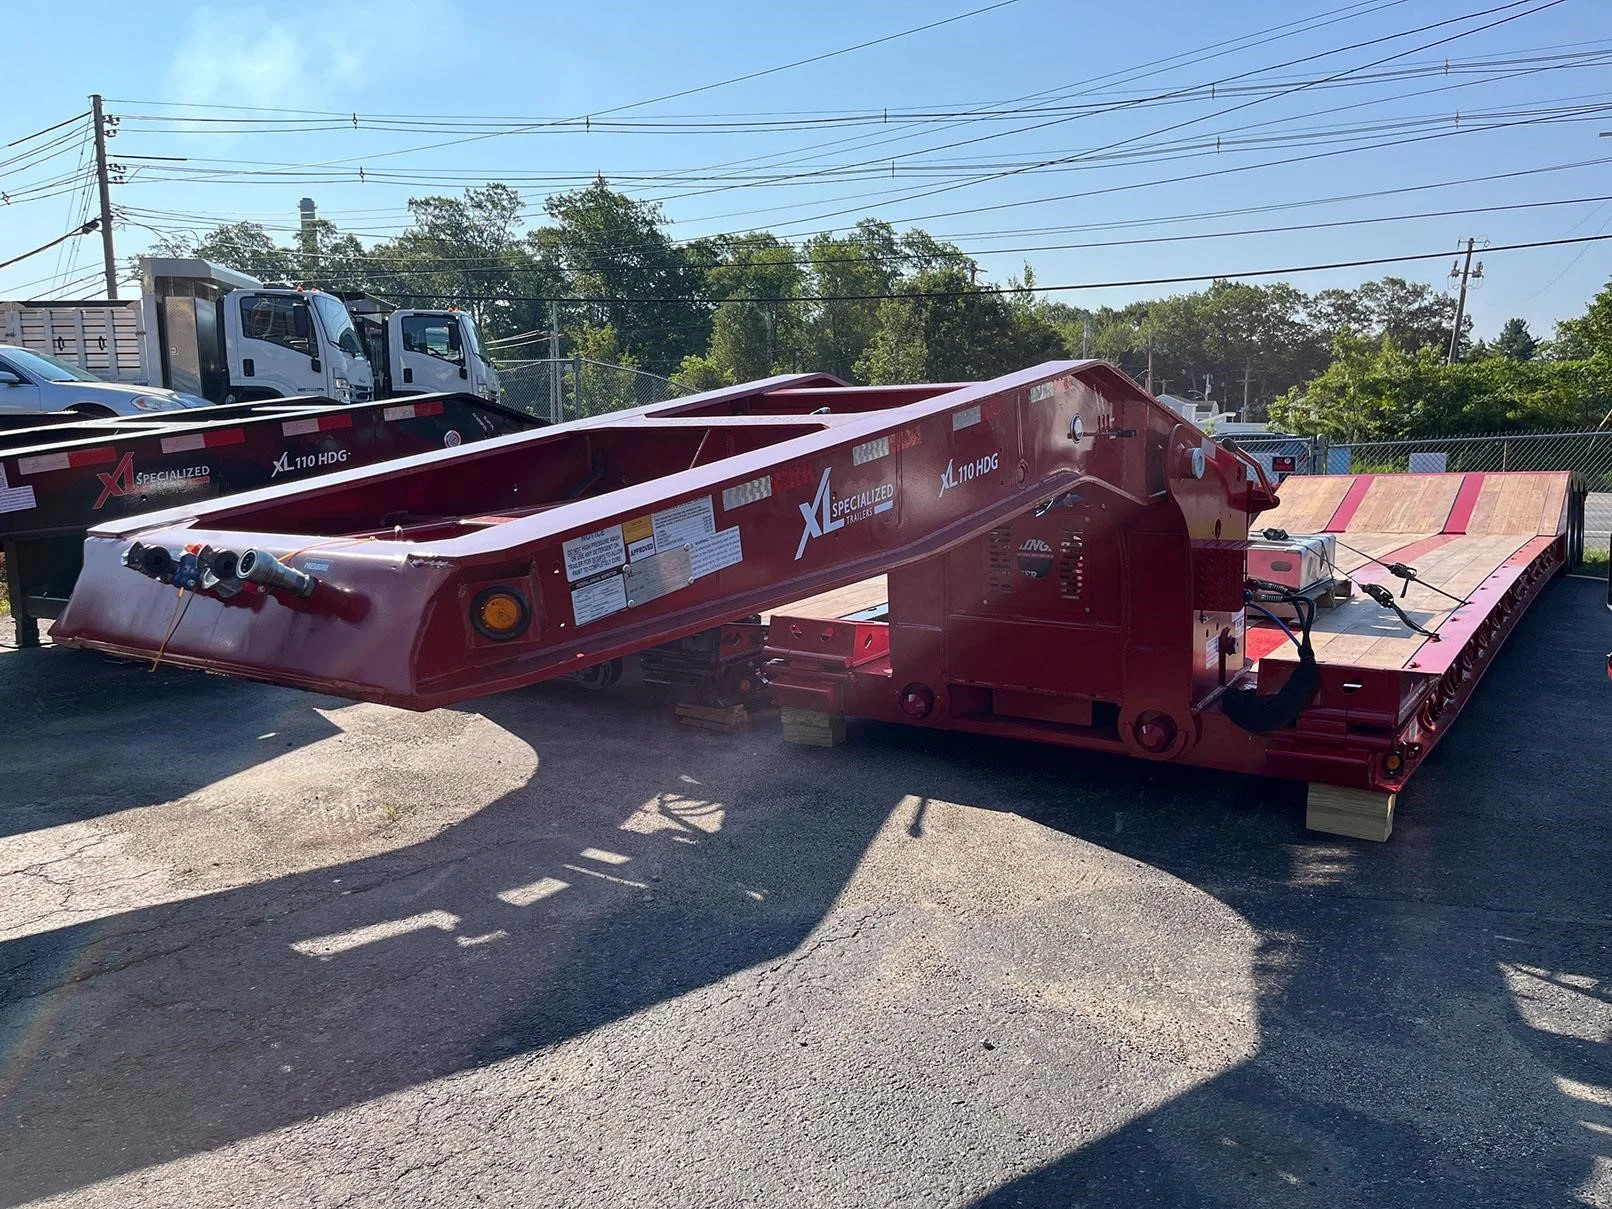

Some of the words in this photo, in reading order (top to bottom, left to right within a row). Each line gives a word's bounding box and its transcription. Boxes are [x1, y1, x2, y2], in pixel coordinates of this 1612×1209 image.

[271, 451, 295, 478] XL
[295, 455, 316, 469] 110
[318, 449, 348, 465] HDG
[136, 465, 210, 485] SPECIALIZED
[938, 458, 958, 498] XL
[958, 462, 975, 483] 110
[975, 452, 999, 477] HDG
[795, 466, 845, 560] XL
[832, 483, 894, 517] SPECIALIZED
[846, 507, 873, 525] TRAILERS
[581, 531, 605, 542] NOTICE
[630, 543, 654, 557] APPROVED
[303, 561, 330, 572] PRESSURE
